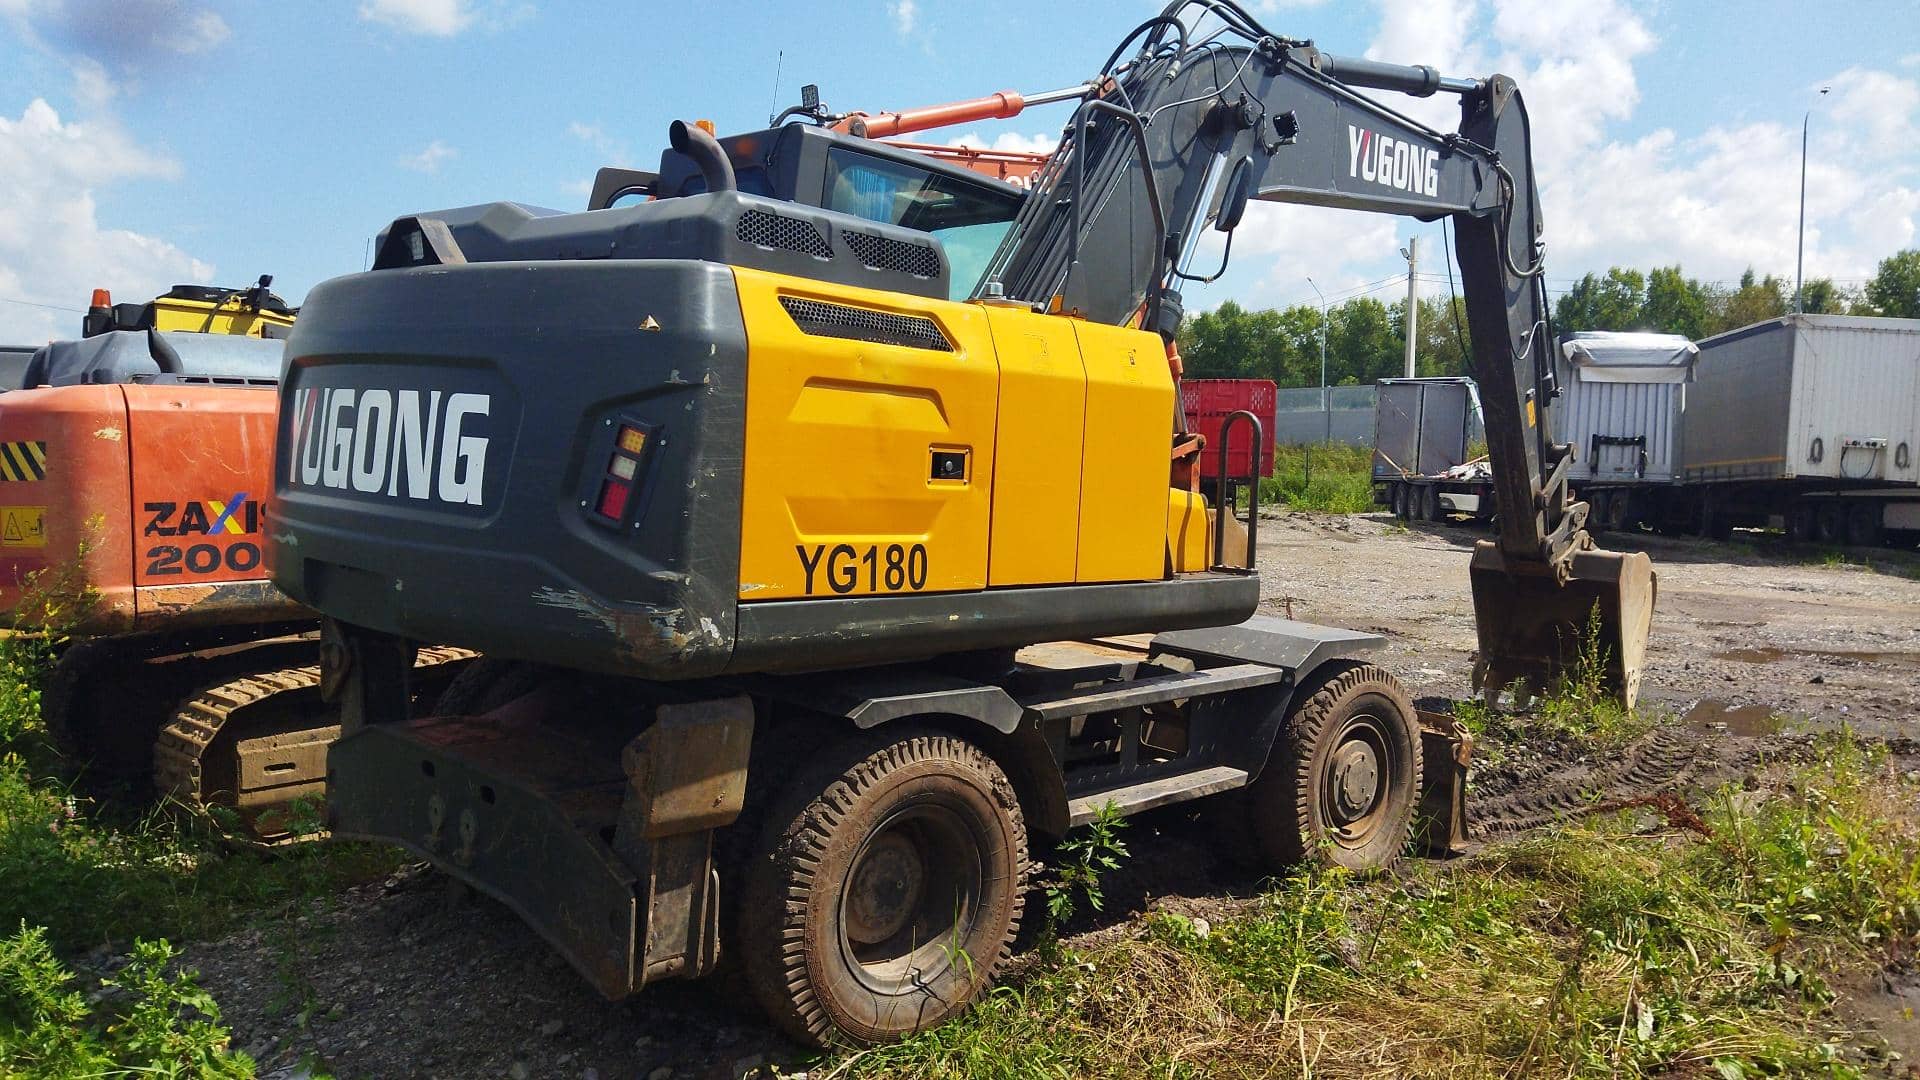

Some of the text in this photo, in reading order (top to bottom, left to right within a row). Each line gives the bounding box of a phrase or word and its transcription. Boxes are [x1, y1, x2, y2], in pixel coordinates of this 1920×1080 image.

[1348, 125, 1439, 197] YUGONG
[290, 388, 490, 505] YUGONG
[144, 492, 266, 537] ZAXI
[146, 542, 261, 576] 200
[795, 543, 928, 595] YG180
